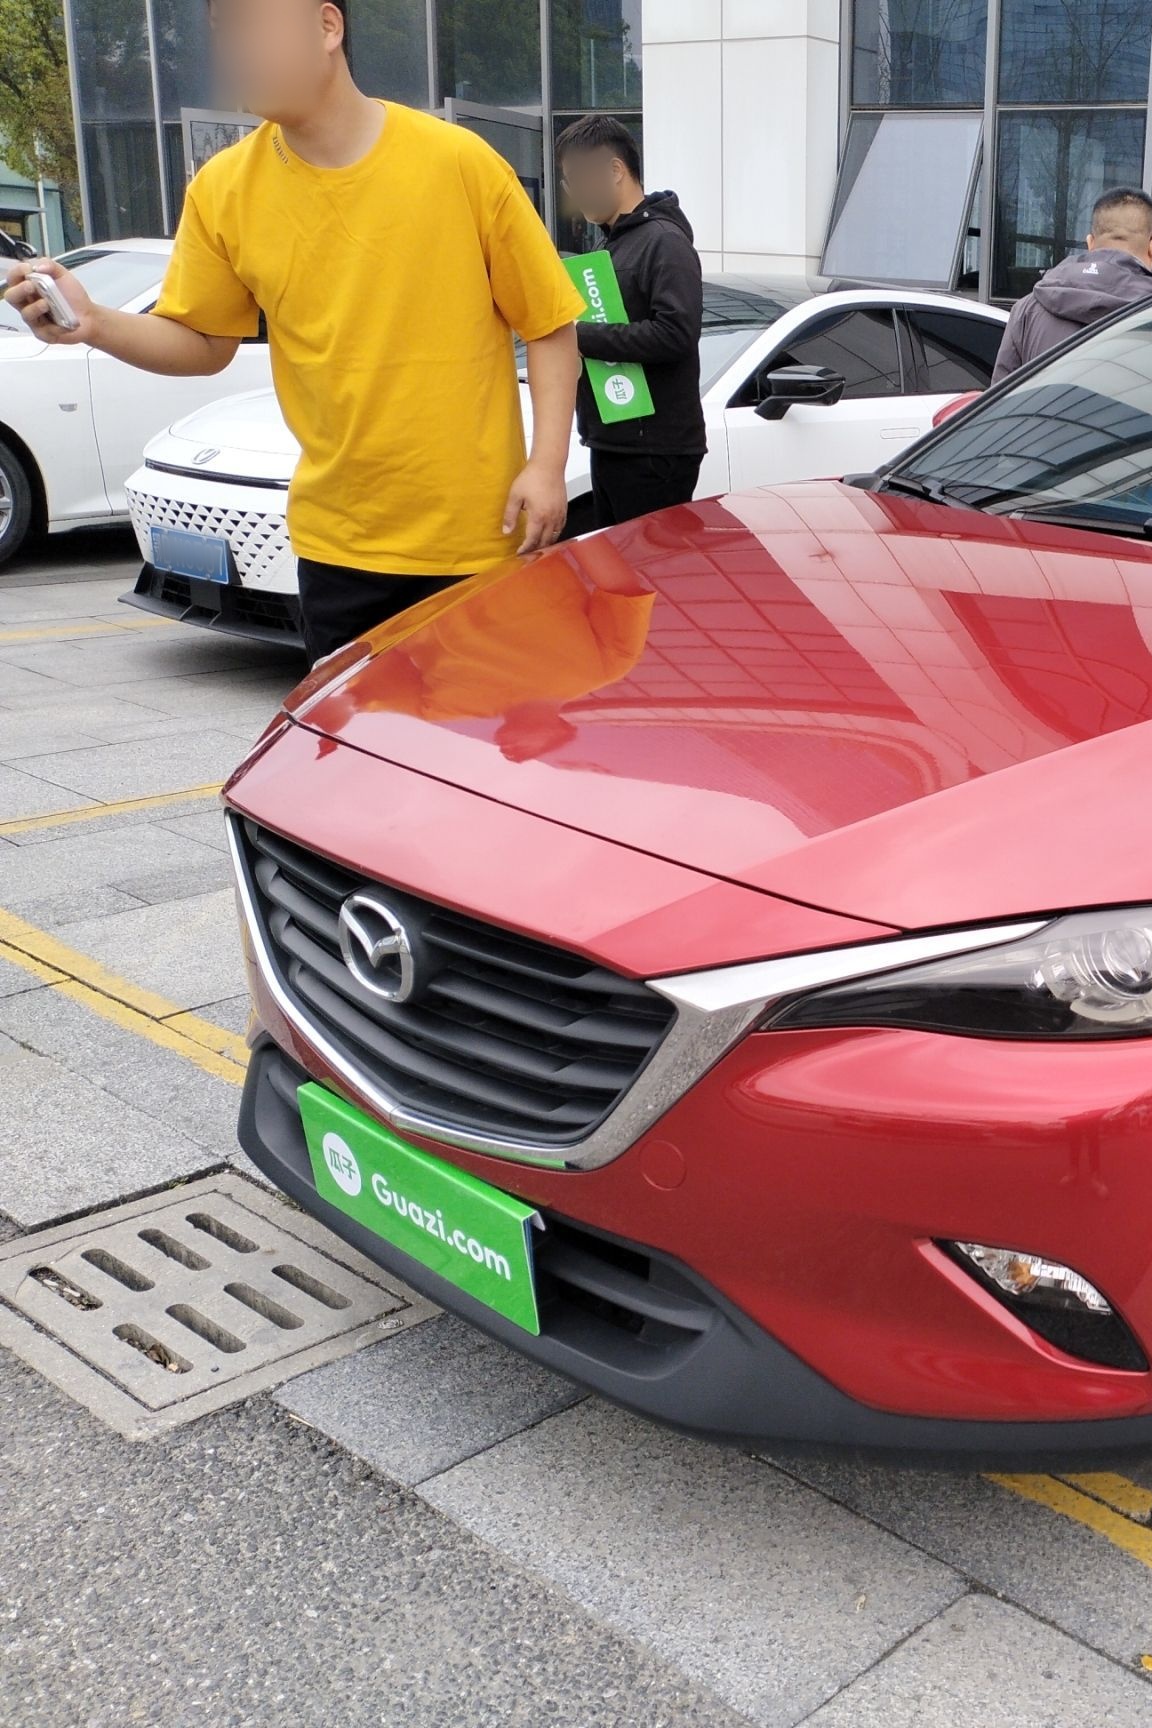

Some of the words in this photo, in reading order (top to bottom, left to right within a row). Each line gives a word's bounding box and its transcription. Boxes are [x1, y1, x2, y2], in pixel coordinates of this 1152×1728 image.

[612, 378, 627, 400] 瓜子
[328, 1147, 356, 1180] 瓜子
[371, 1172, 512, 1282] Guazi.com
